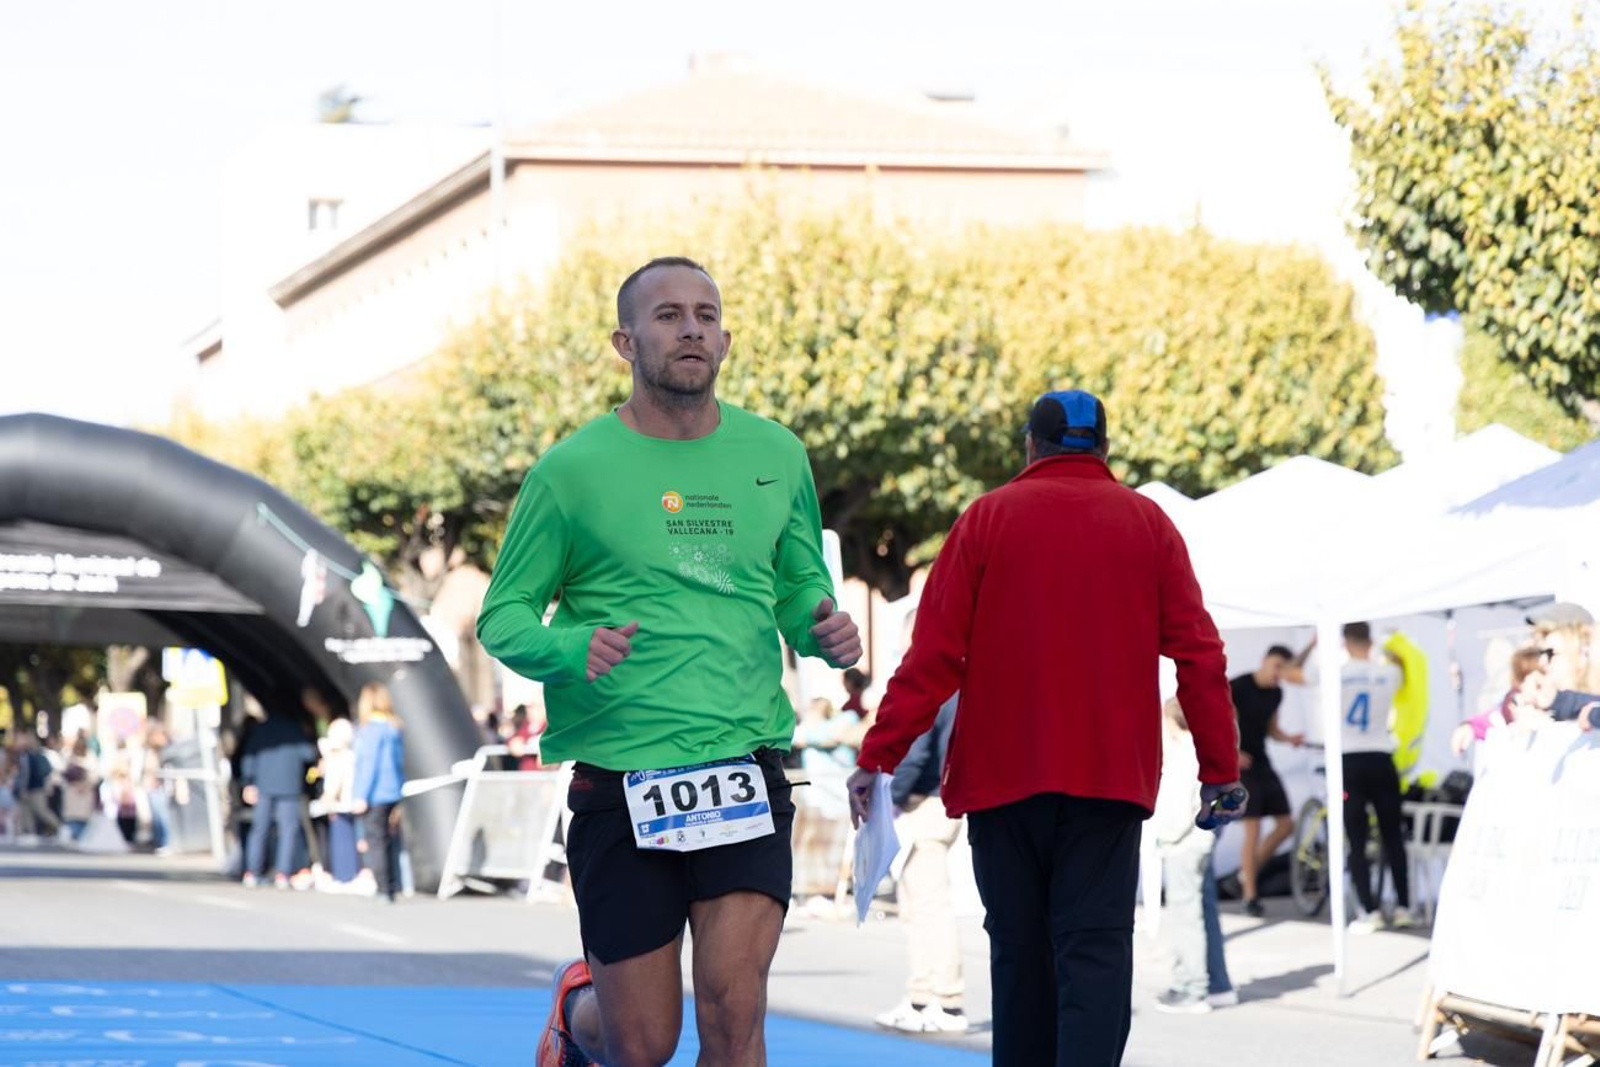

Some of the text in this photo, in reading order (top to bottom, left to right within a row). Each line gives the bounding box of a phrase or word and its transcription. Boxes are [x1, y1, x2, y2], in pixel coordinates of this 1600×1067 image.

[1346, 692, 1369, 732] 4
[642, 772, 757, 817] 1013
[686, 811, 721, 822] ANTONIO
